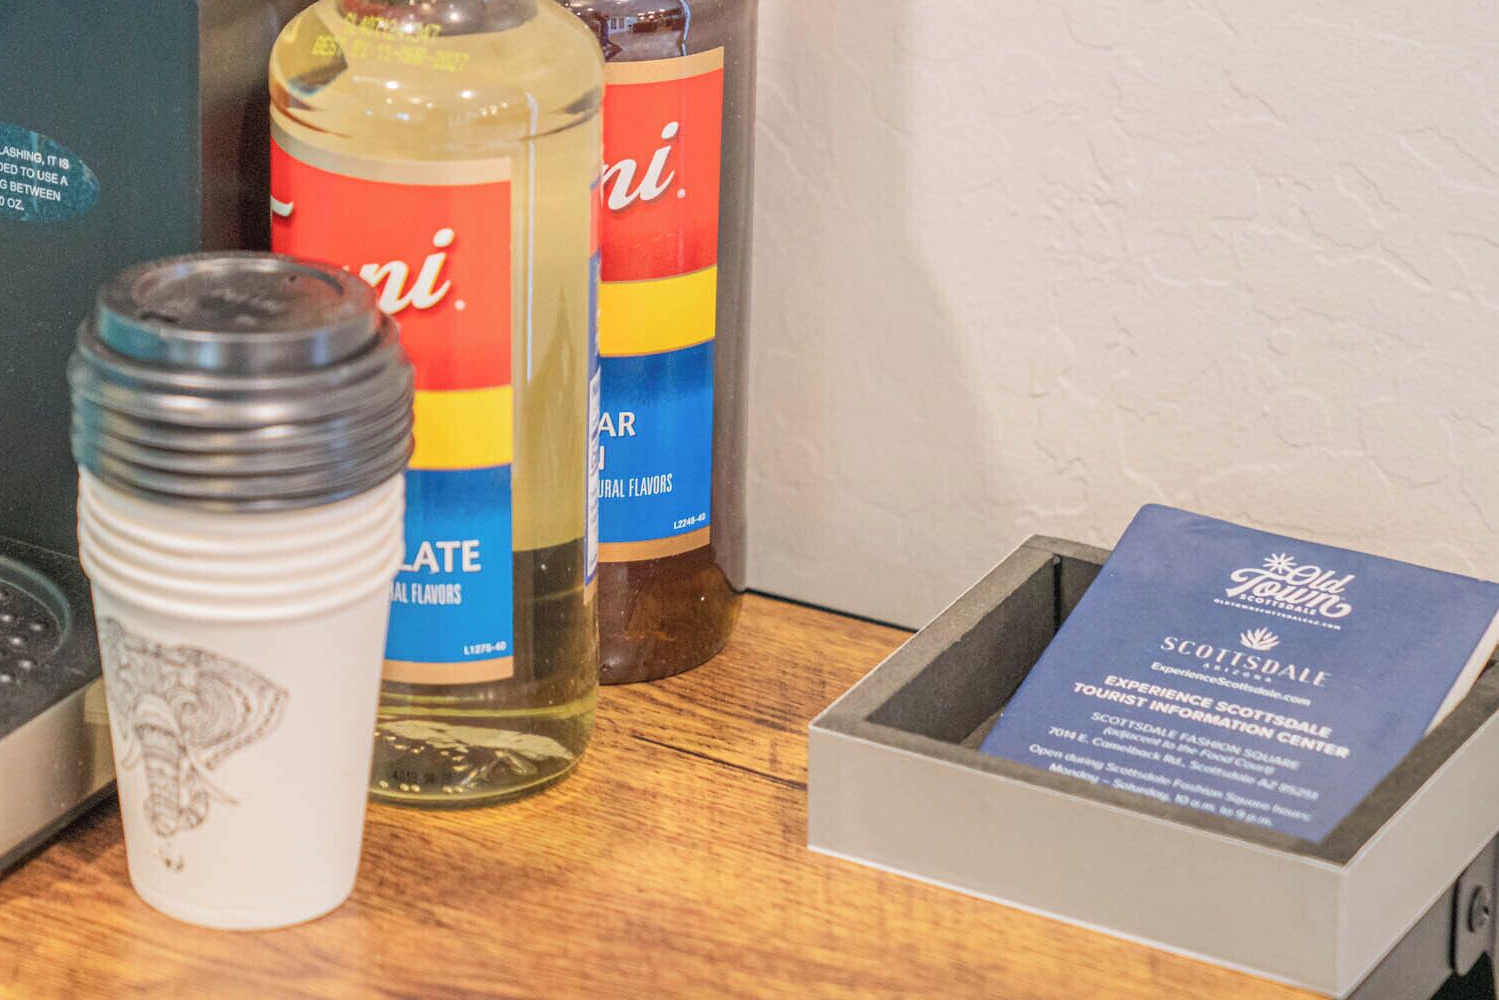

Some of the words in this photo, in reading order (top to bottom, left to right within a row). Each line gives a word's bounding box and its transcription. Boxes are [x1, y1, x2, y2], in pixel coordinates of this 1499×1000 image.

[47, 155, 57, 167] IT
[58, 157, 70, 171] IS
[19, 166, 35, 179] TO
[36, 171, 59, 184] USE
[60, 175, 69, 187] A
[6, 198, 26, 211] OZ.
[9, 181, 62, 202] BETWEEN
[628, 472, 674, 498] FLAVORS
[1285, 565, 1356, 593] Old
[410, 583, 462, 606] FLAVORS
[1225, 567, 1353, 619] Town
[1238, 593, 1318, 616] SCOTTSDALE
[1160, 636, 1333, 688] SCOTTSDALE
[1202, 662, 1273, 683] ARIZONA
[1150, 661, 1312, 707] ExperienceScottsdale.com
[1104, 674, 1214, 709] EXPERIENCE
[1215, 698, 1334, 740] SCOTTSDALE
[1073, 681, 1150, 708] TOURIST
[1149, 699, 1275, 740] INFORMATION
[1276, 730, 1351, 760] CENTER
[1090, 710, 1178, 740] SCOTTSDALE
[1179, 731, 1242, 755] FASHION
[1242, 748, 1300, 771] SQUARE
[1161, 740, 1176, 751] to
[1176, 743, 1199, 756] the
[1199, 748, 1235, 765] Food
[1048, 761, 1100, 785] Monday
[1092, 737, 1162, 761] Camelback
[1188, 759, 1258, 785] Scottsdale
[1257, 778, 1279, 791] AZ
[1029, 743, 1063, 760] Open
[1064, 752, 1105, 771] during
[1105, 762, 1172, 786] Scottsdale
[1172, 778, 1224, 800] Fashion
[1224, 791, 1272, 813] Square
